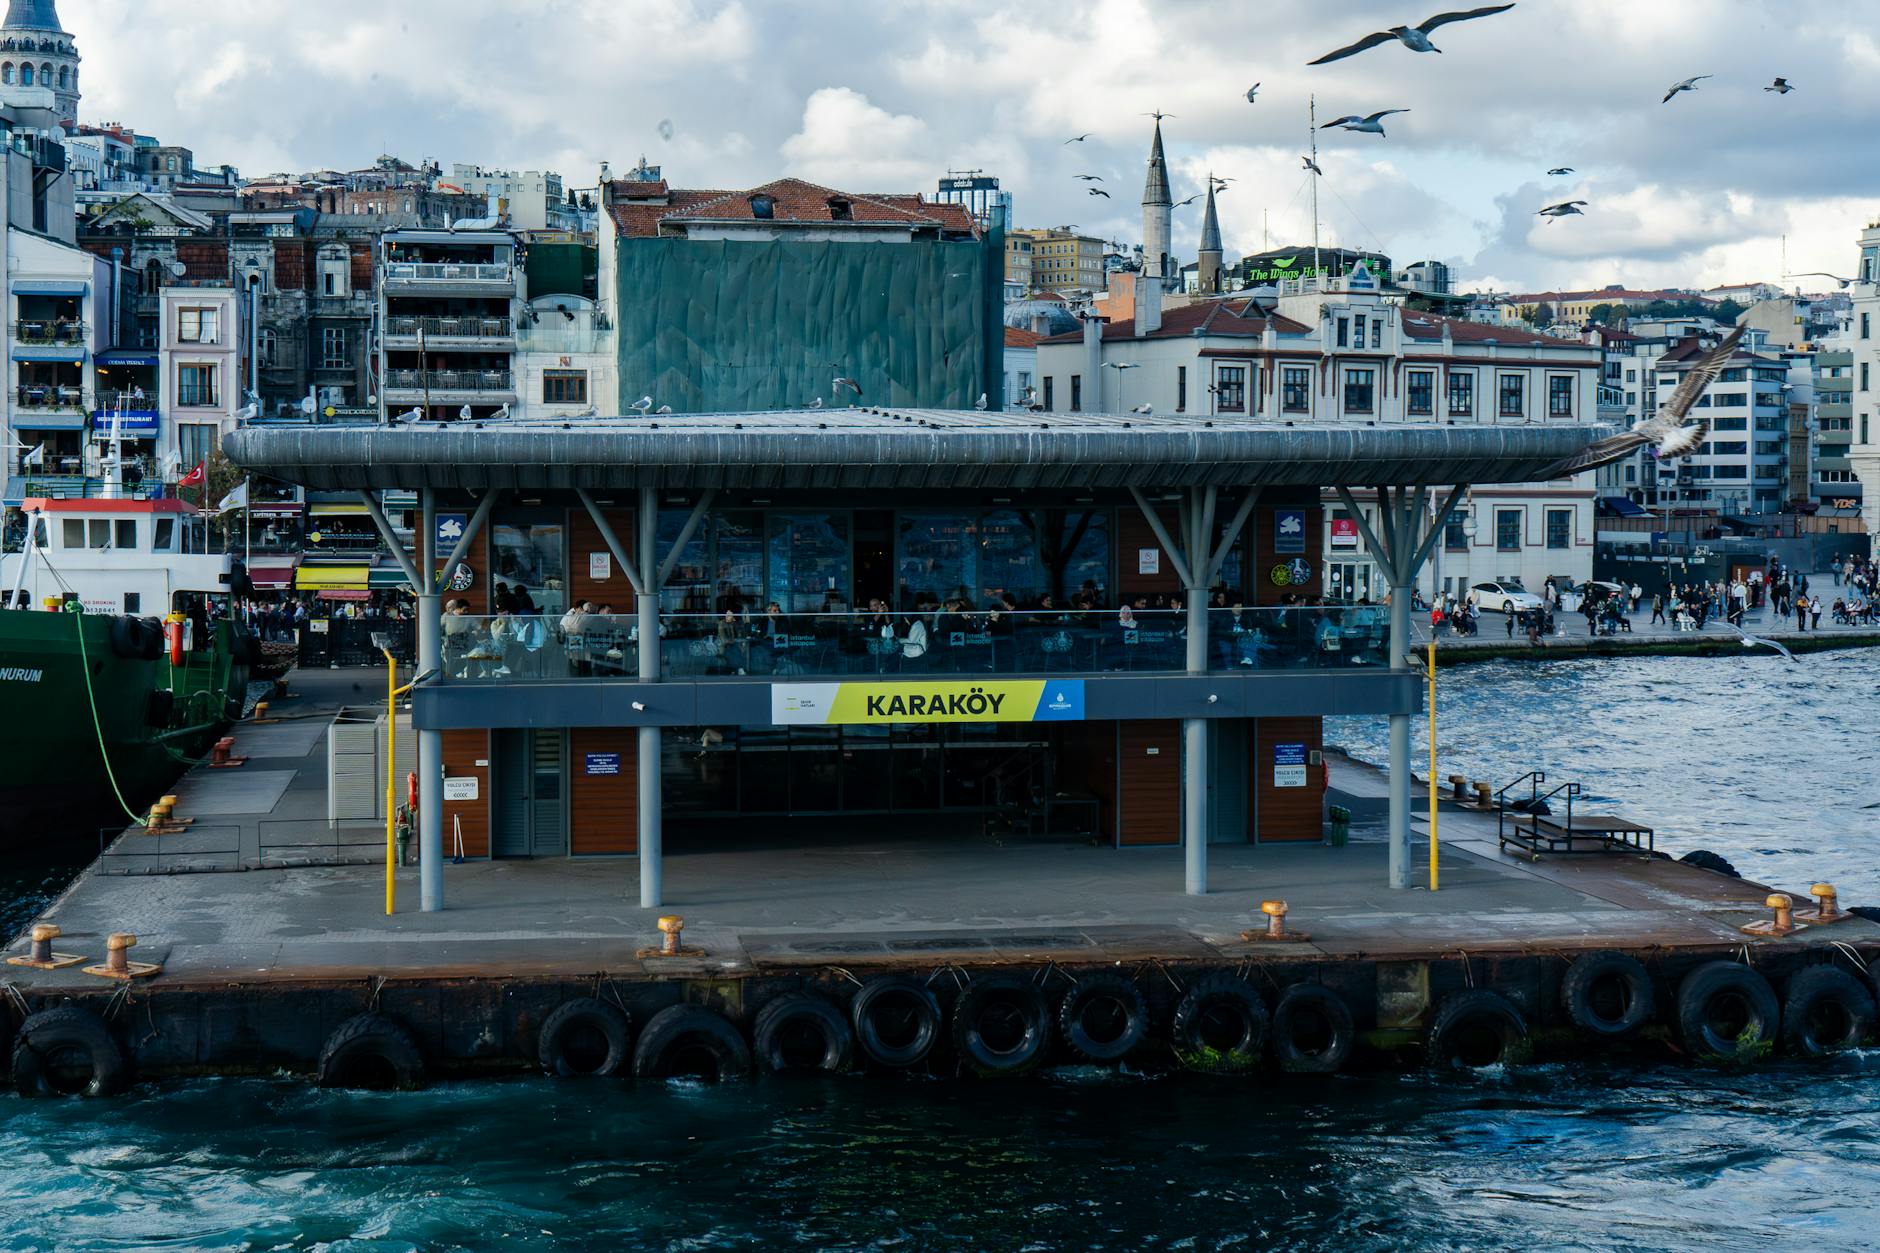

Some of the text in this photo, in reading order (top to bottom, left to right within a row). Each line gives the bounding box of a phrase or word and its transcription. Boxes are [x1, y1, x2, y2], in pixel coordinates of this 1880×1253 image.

[1250, 269, 1268, 281] The
[1270, 268, 1299, 281] Wings
[1303, 265, 1328, 278] Hoel
[867, 687, 1006, 716] KARAKÖY
